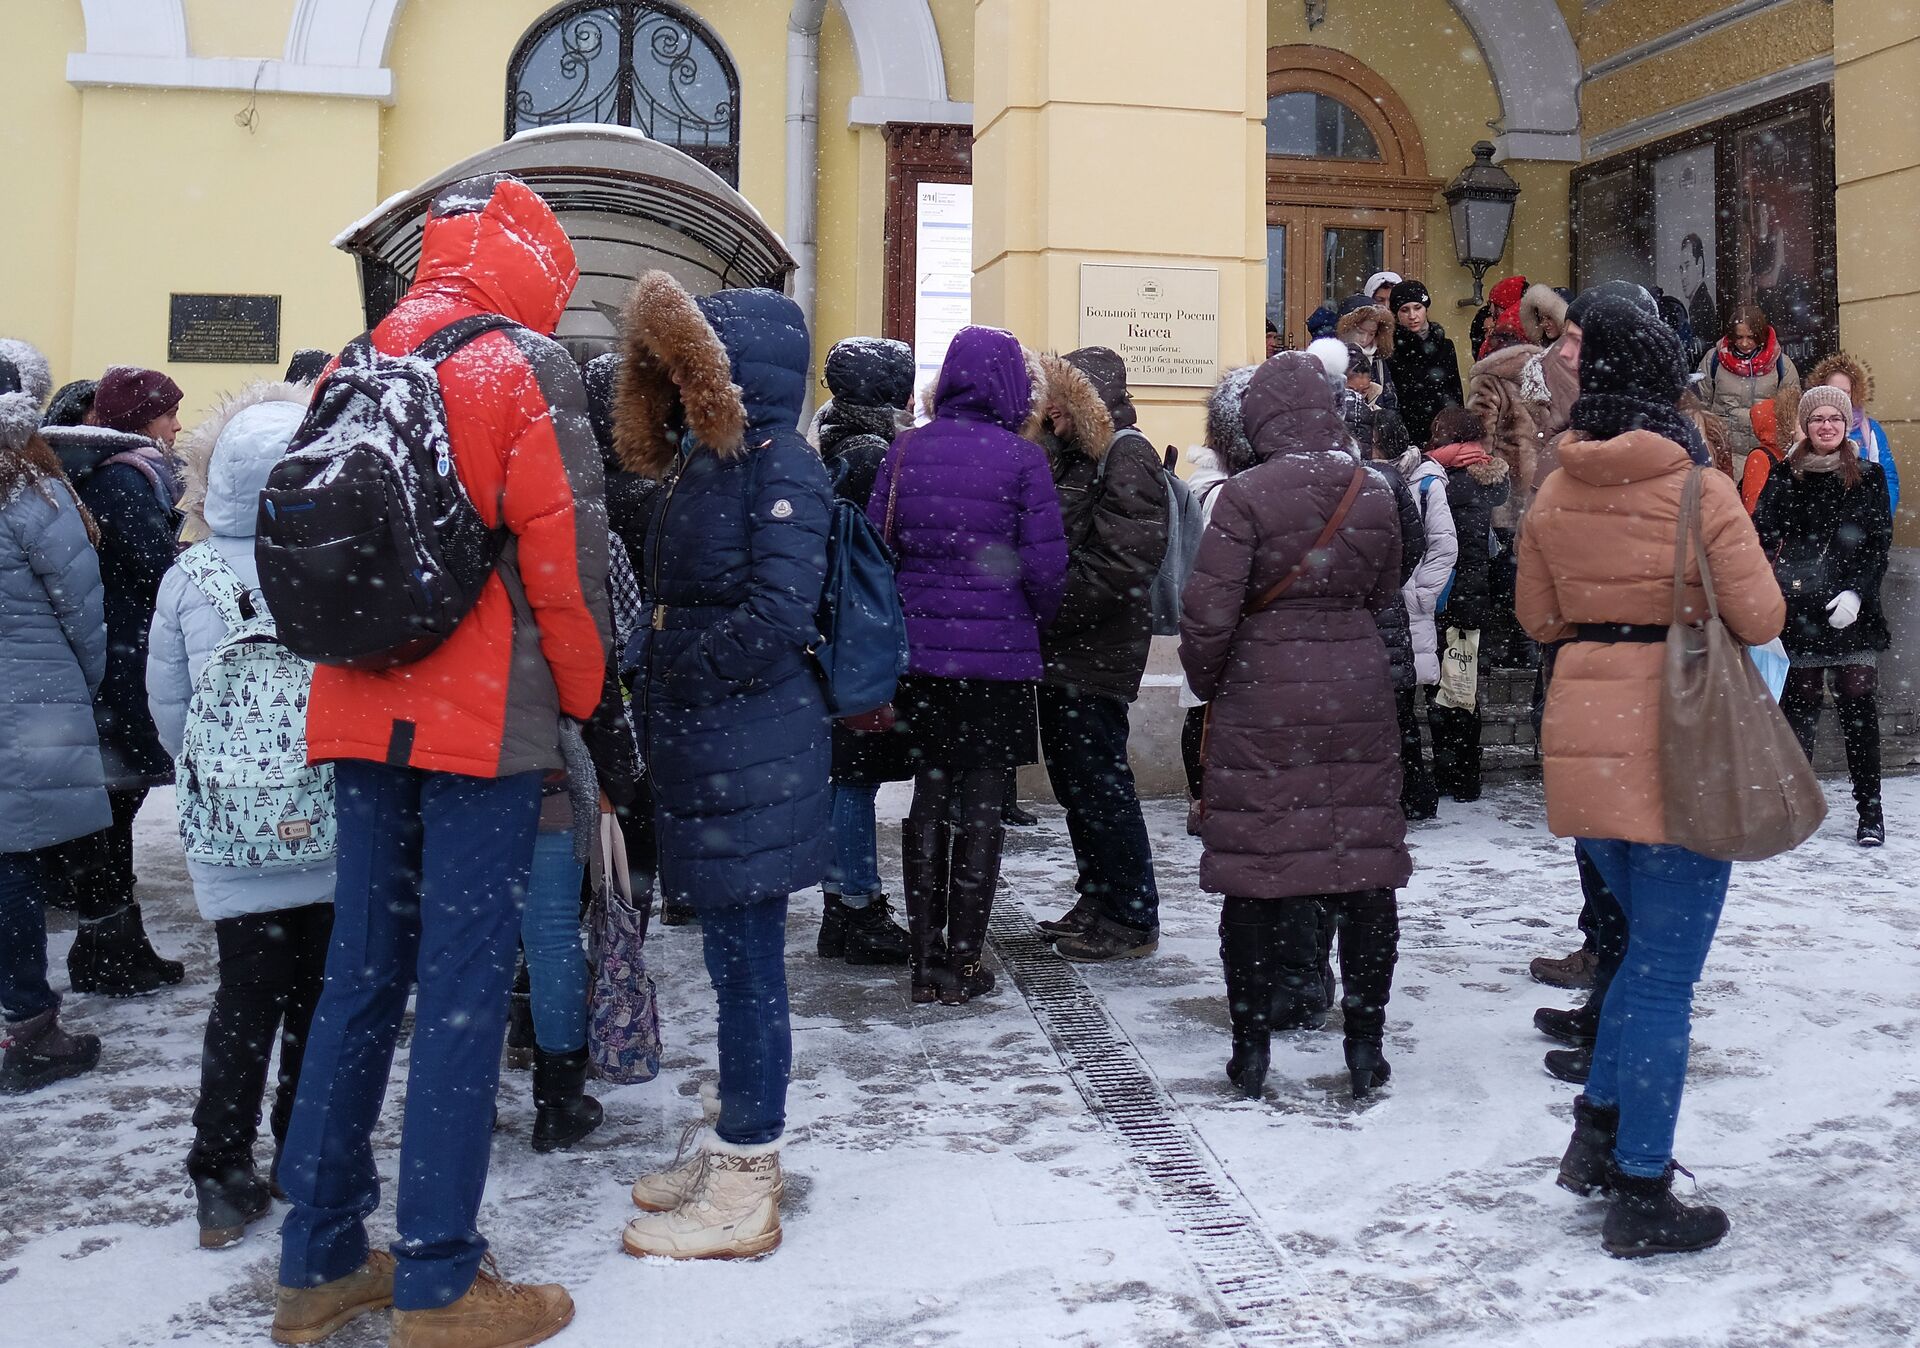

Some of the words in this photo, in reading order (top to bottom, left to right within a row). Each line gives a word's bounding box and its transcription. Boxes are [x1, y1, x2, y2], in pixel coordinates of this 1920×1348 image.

[1086, 306, 1137, 319] Большой
[1141, 311, 1172, 322] театр
[1177, 309, 1215, 321] России
[1128, 323, 1171, 339] Касса
[1120, 343, 1146, 353] Время
[1131, 355, 1155, 363] 20:00
[1157, 356, 1171, 364] без
[1173, 357, 1214, 366] выходных
[1142, 365, 1165, 373] 15:00
[1181, 366, 1203, 374] 16:00
